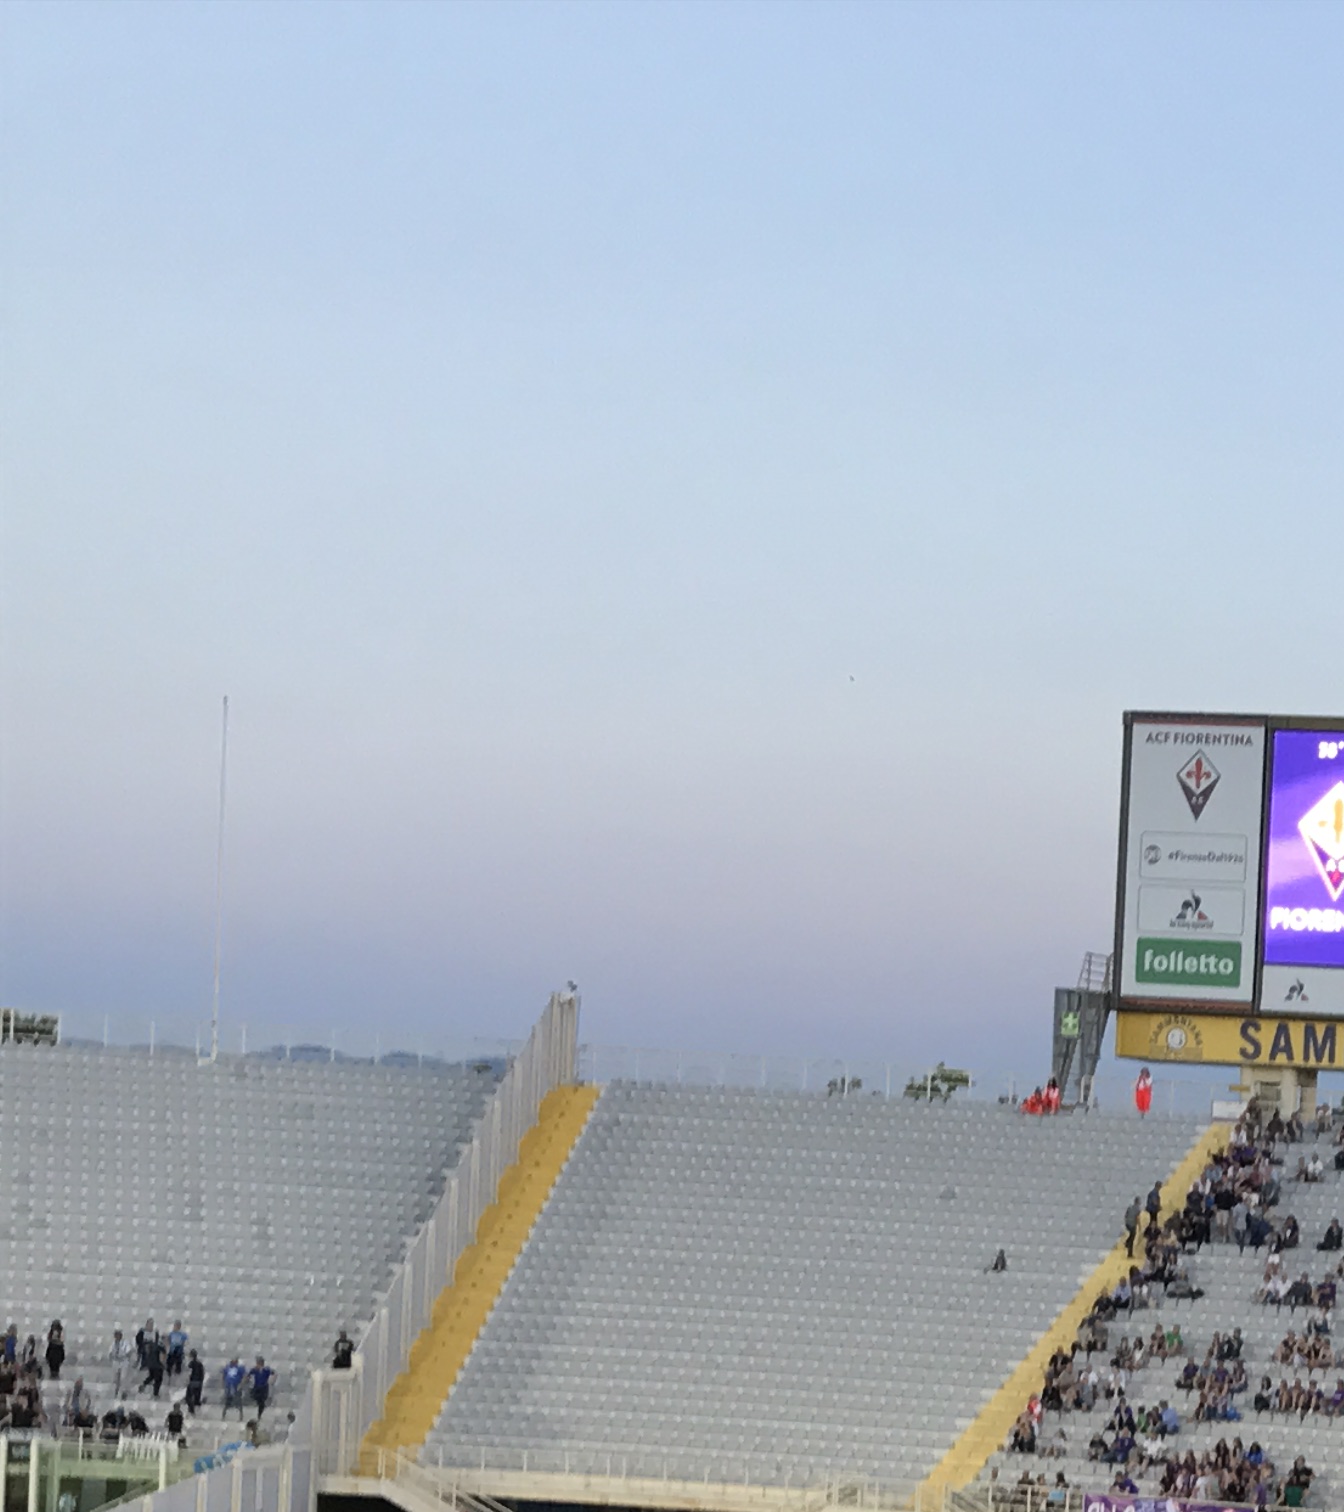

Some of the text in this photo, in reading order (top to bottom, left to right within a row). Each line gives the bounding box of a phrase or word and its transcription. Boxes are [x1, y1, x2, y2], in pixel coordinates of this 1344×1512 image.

[1145, 731, 1254, 747] ACF FIORENTINA
[1143, 948, 1234, 975] folletto
